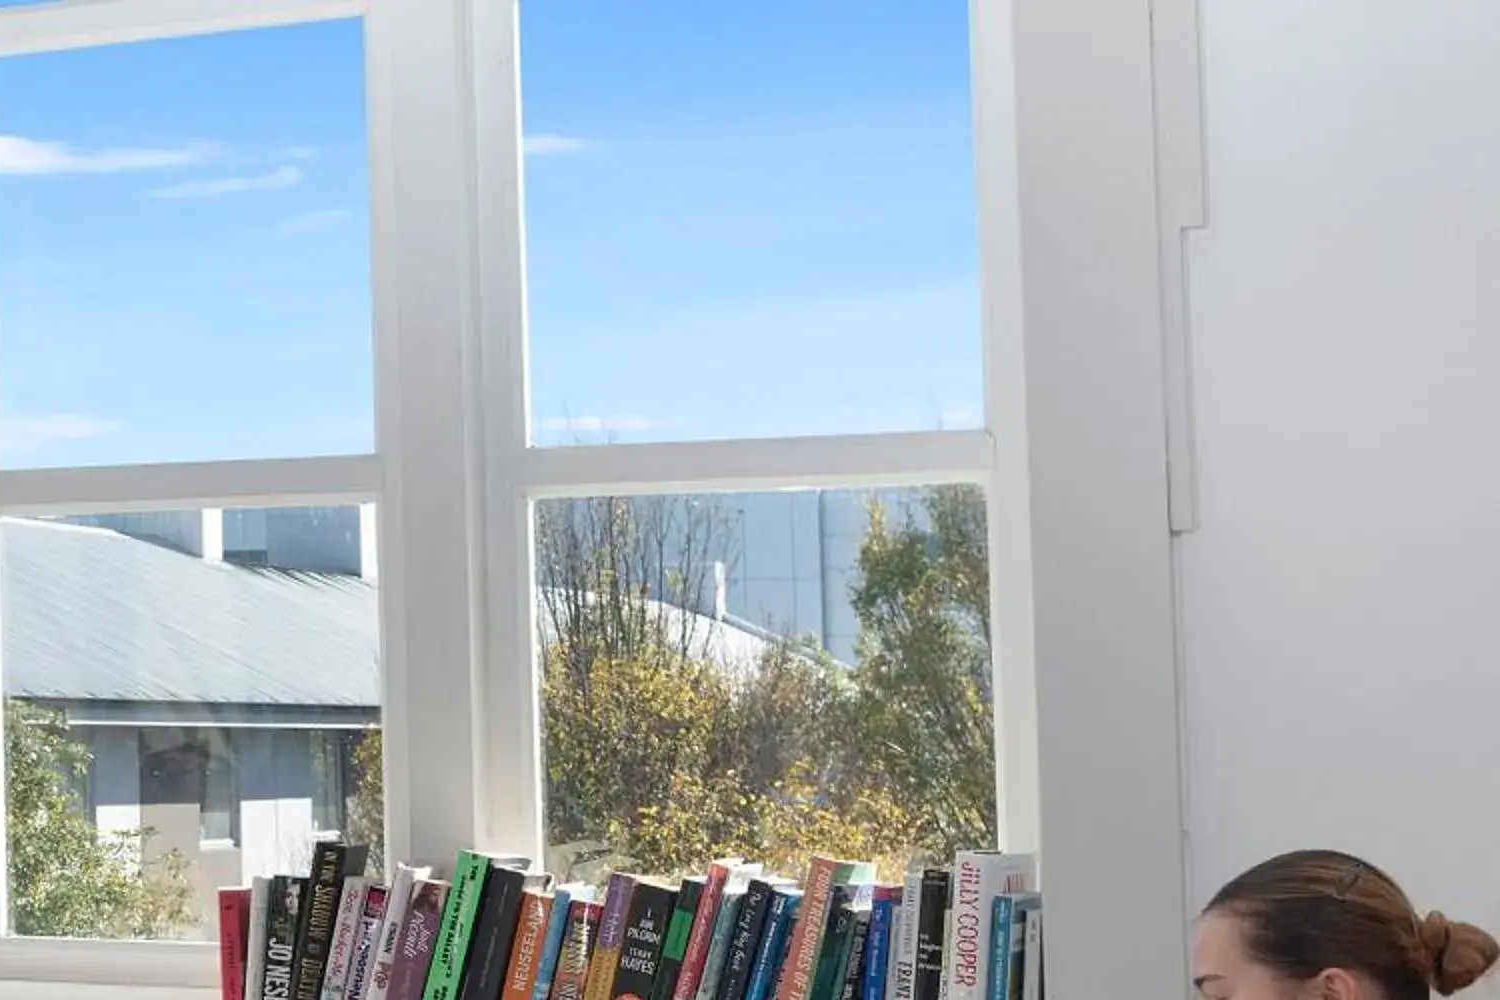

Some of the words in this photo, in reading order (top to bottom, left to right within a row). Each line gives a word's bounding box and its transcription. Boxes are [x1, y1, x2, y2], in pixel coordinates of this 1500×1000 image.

[958, 861, 982, 909] JILLY
[307, 883, 334, 940] SHADOW
[267, 937, 293, 961] JO
[416, 927, 434, 953] Jodi
[510, 898, 545, 991] NEUSEELAND
[796, 900, 824, 971] TREASURES
[952, 912, 980, 987] COOPER
[296, 957, 322, 1000] DEATH
[371, 960, 390, 990] POP
[621, 955, 656, 976] HAYES
[792, 971, 807, 987] OF
[895, 960, 912, 999] FRANZ
